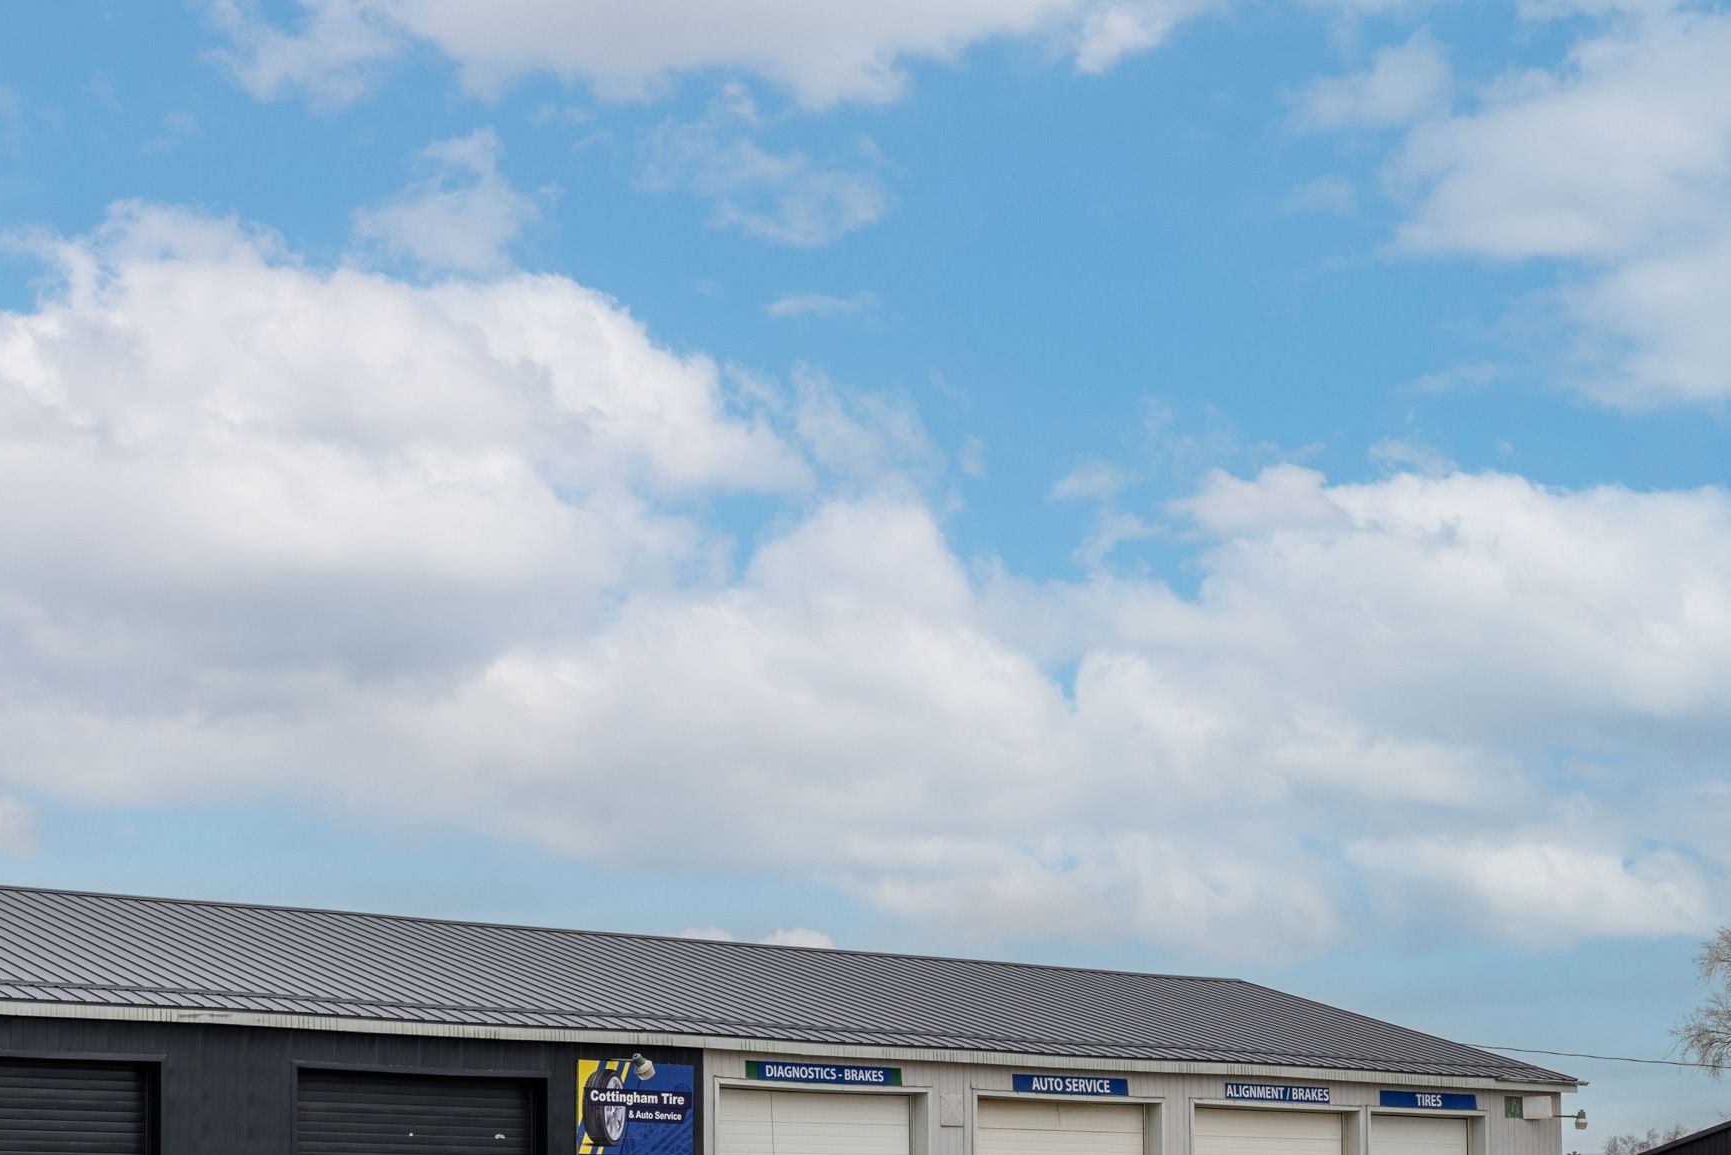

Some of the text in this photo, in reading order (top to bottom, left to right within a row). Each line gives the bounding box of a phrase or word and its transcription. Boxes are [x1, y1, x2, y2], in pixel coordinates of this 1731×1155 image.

[765, 1064, 837, 1080] DIAGNOSTICS
[844, 1069, 884, 1082] BRAKES
[1032, 1077, 1111, 1093] AUTO SERVICE
[1226, 1084, 1285, 1099] ALIGNMENT
[1291, 1087, 1329, 1101] BRAKES
[590, 1090, 685, 1105] Cottingham Tire
[1416, 1093, 1443, 1108] TIRES
[628, 1110, 682, 1121] & Auto Service
